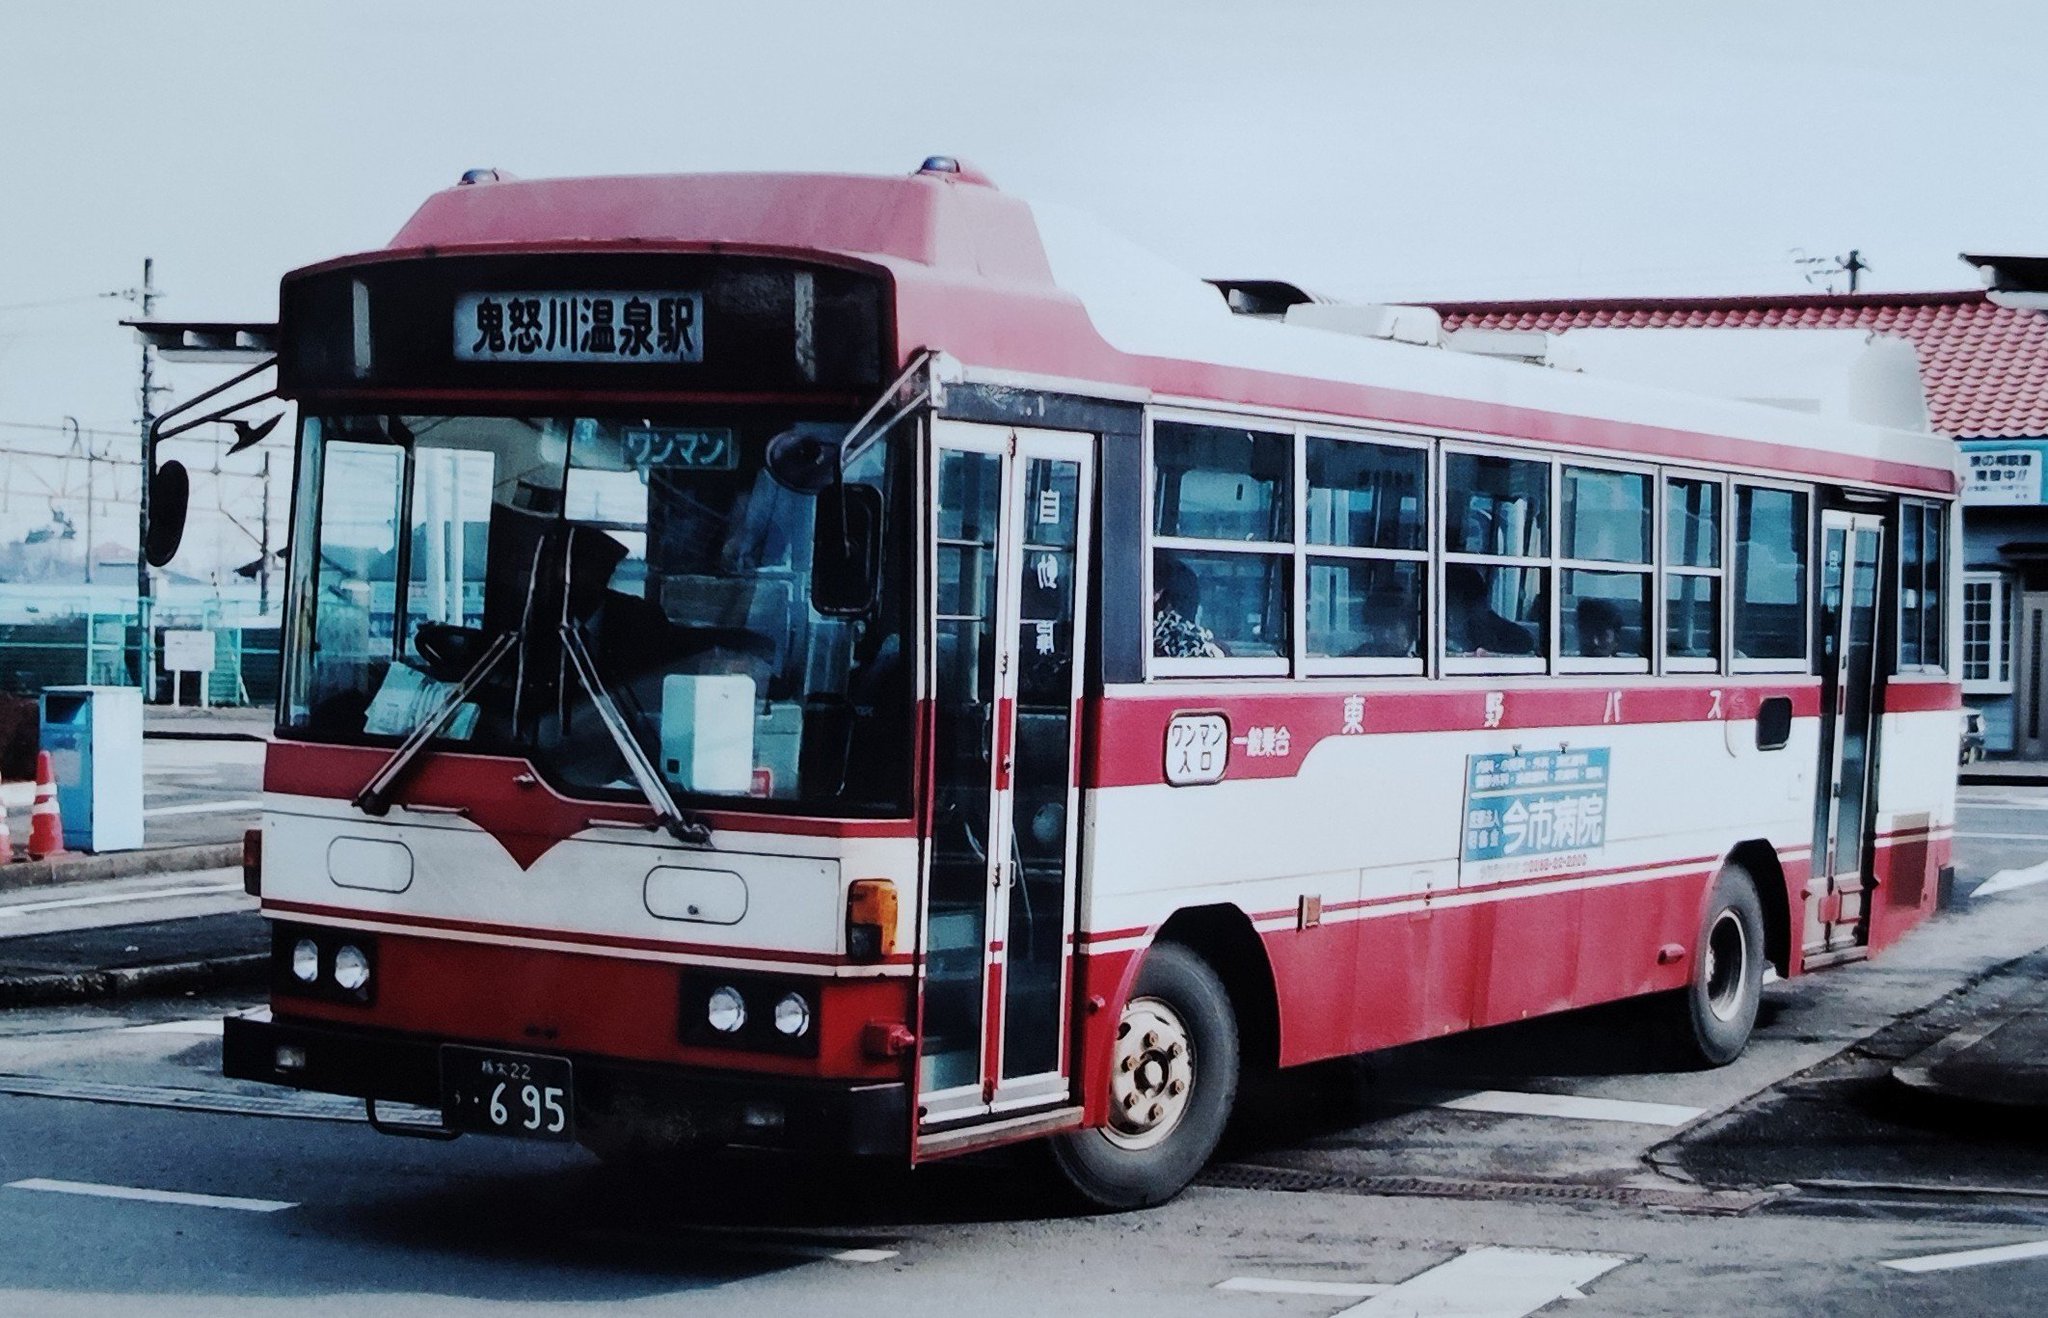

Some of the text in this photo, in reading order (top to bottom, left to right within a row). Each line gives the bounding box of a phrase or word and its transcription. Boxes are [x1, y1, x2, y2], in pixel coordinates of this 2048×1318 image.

[472, 296, 694, 355] 鬼怒川温泉駅
[627, 431, 724, 464] ワンマン
[1342, 689, 1722, 735] 東野バス
[1172, 724, 1224, 747] ワンマン
[1178, 750, 1212, 774] 入口
[1502, 793, 1603, 855] 今市病院
